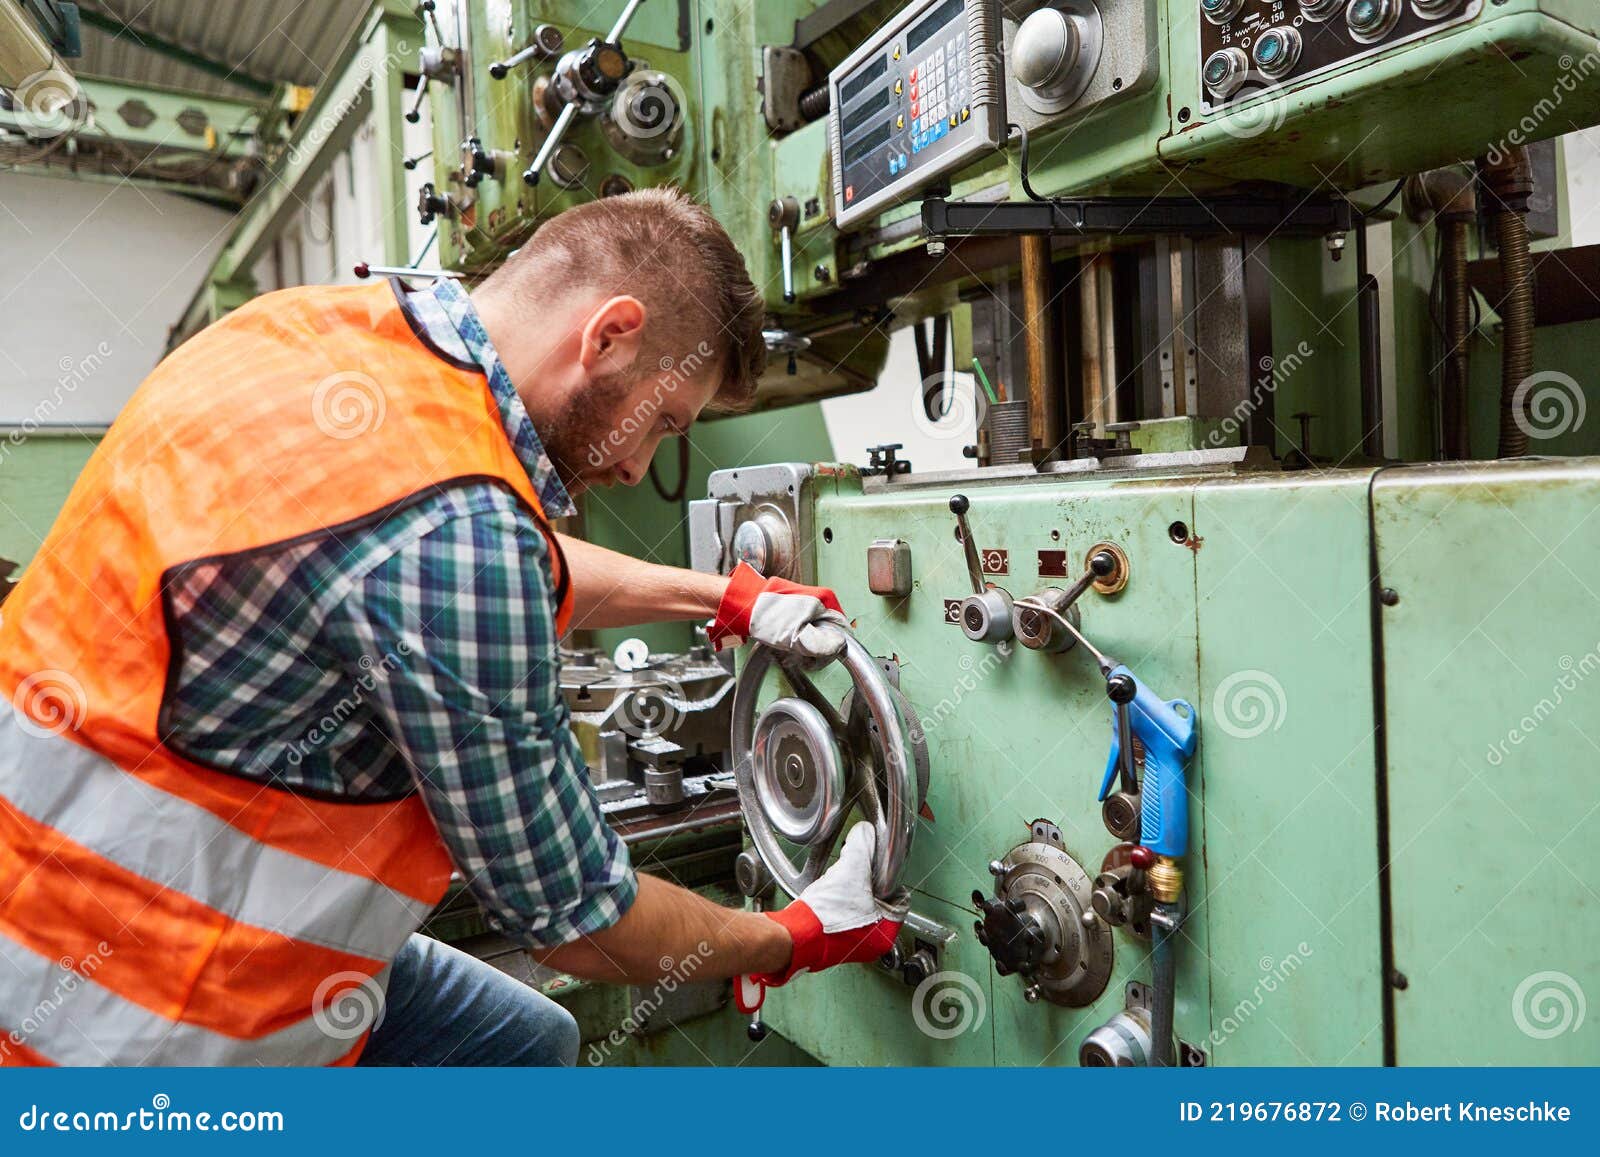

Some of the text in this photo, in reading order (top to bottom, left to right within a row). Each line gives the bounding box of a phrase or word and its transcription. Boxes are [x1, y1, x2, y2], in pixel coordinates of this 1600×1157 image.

[1272, 1, 1283, 12] 50
[1271, 11, 1285, 23] 150
[1221, 23, 1231, 34] 25
